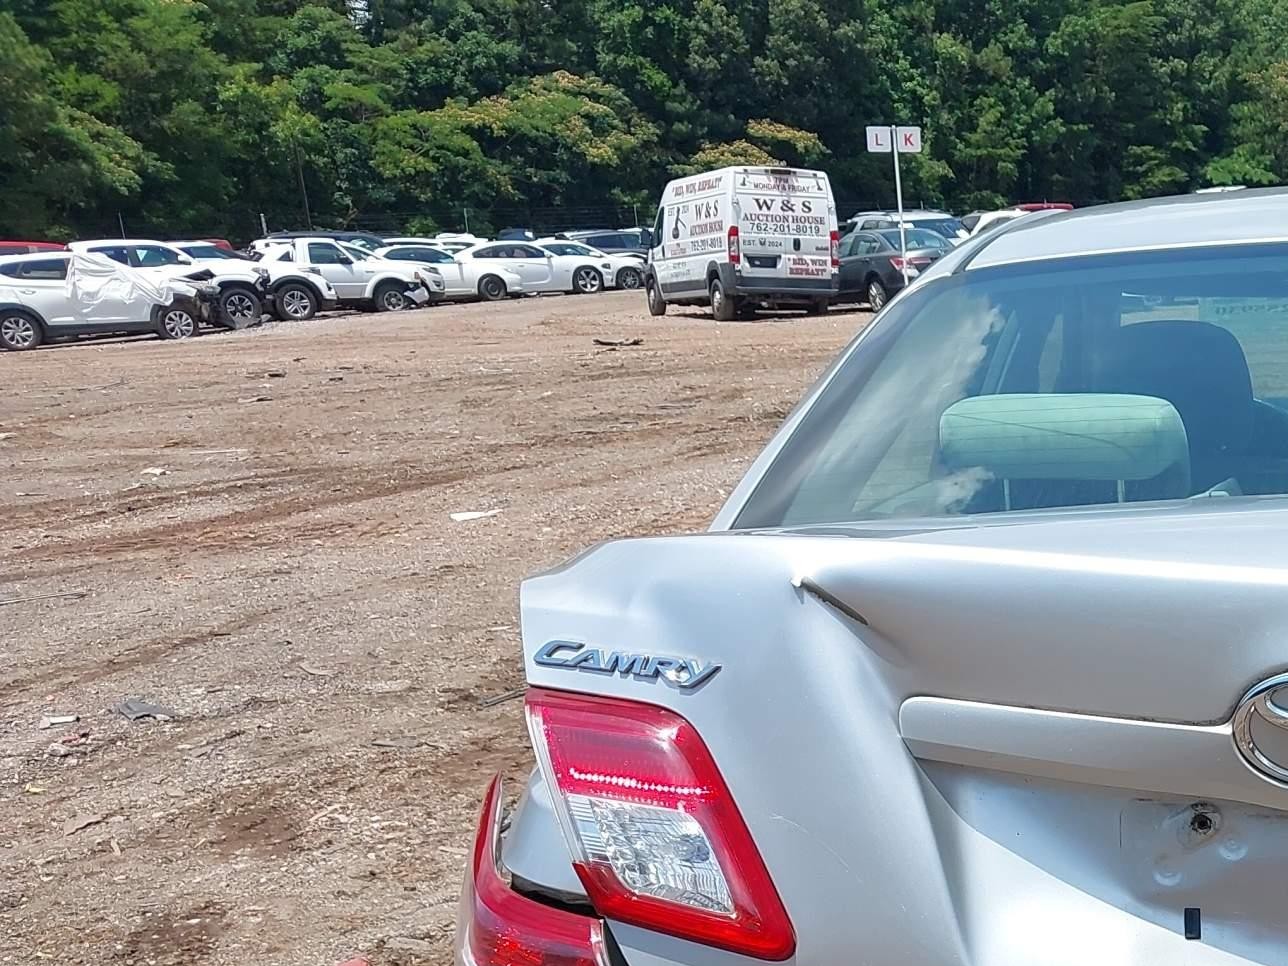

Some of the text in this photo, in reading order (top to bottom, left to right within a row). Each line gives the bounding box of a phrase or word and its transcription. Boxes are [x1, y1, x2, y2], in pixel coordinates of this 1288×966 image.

[875, 133, 884, 146] L
[903, 133, 914, 146] K
[753, 182, 780, 192] MONDAY
[788, 184, 810, 193] FRIDAY
[694, 199, 719, 221] W & S
[752, 197, 812, 214] W & S
[742, 213, 826, 225] AUCTION HOUSE
[749, 222, 820, 234] 762-201-8019
[533, 639, 723, 690] CAMRY
